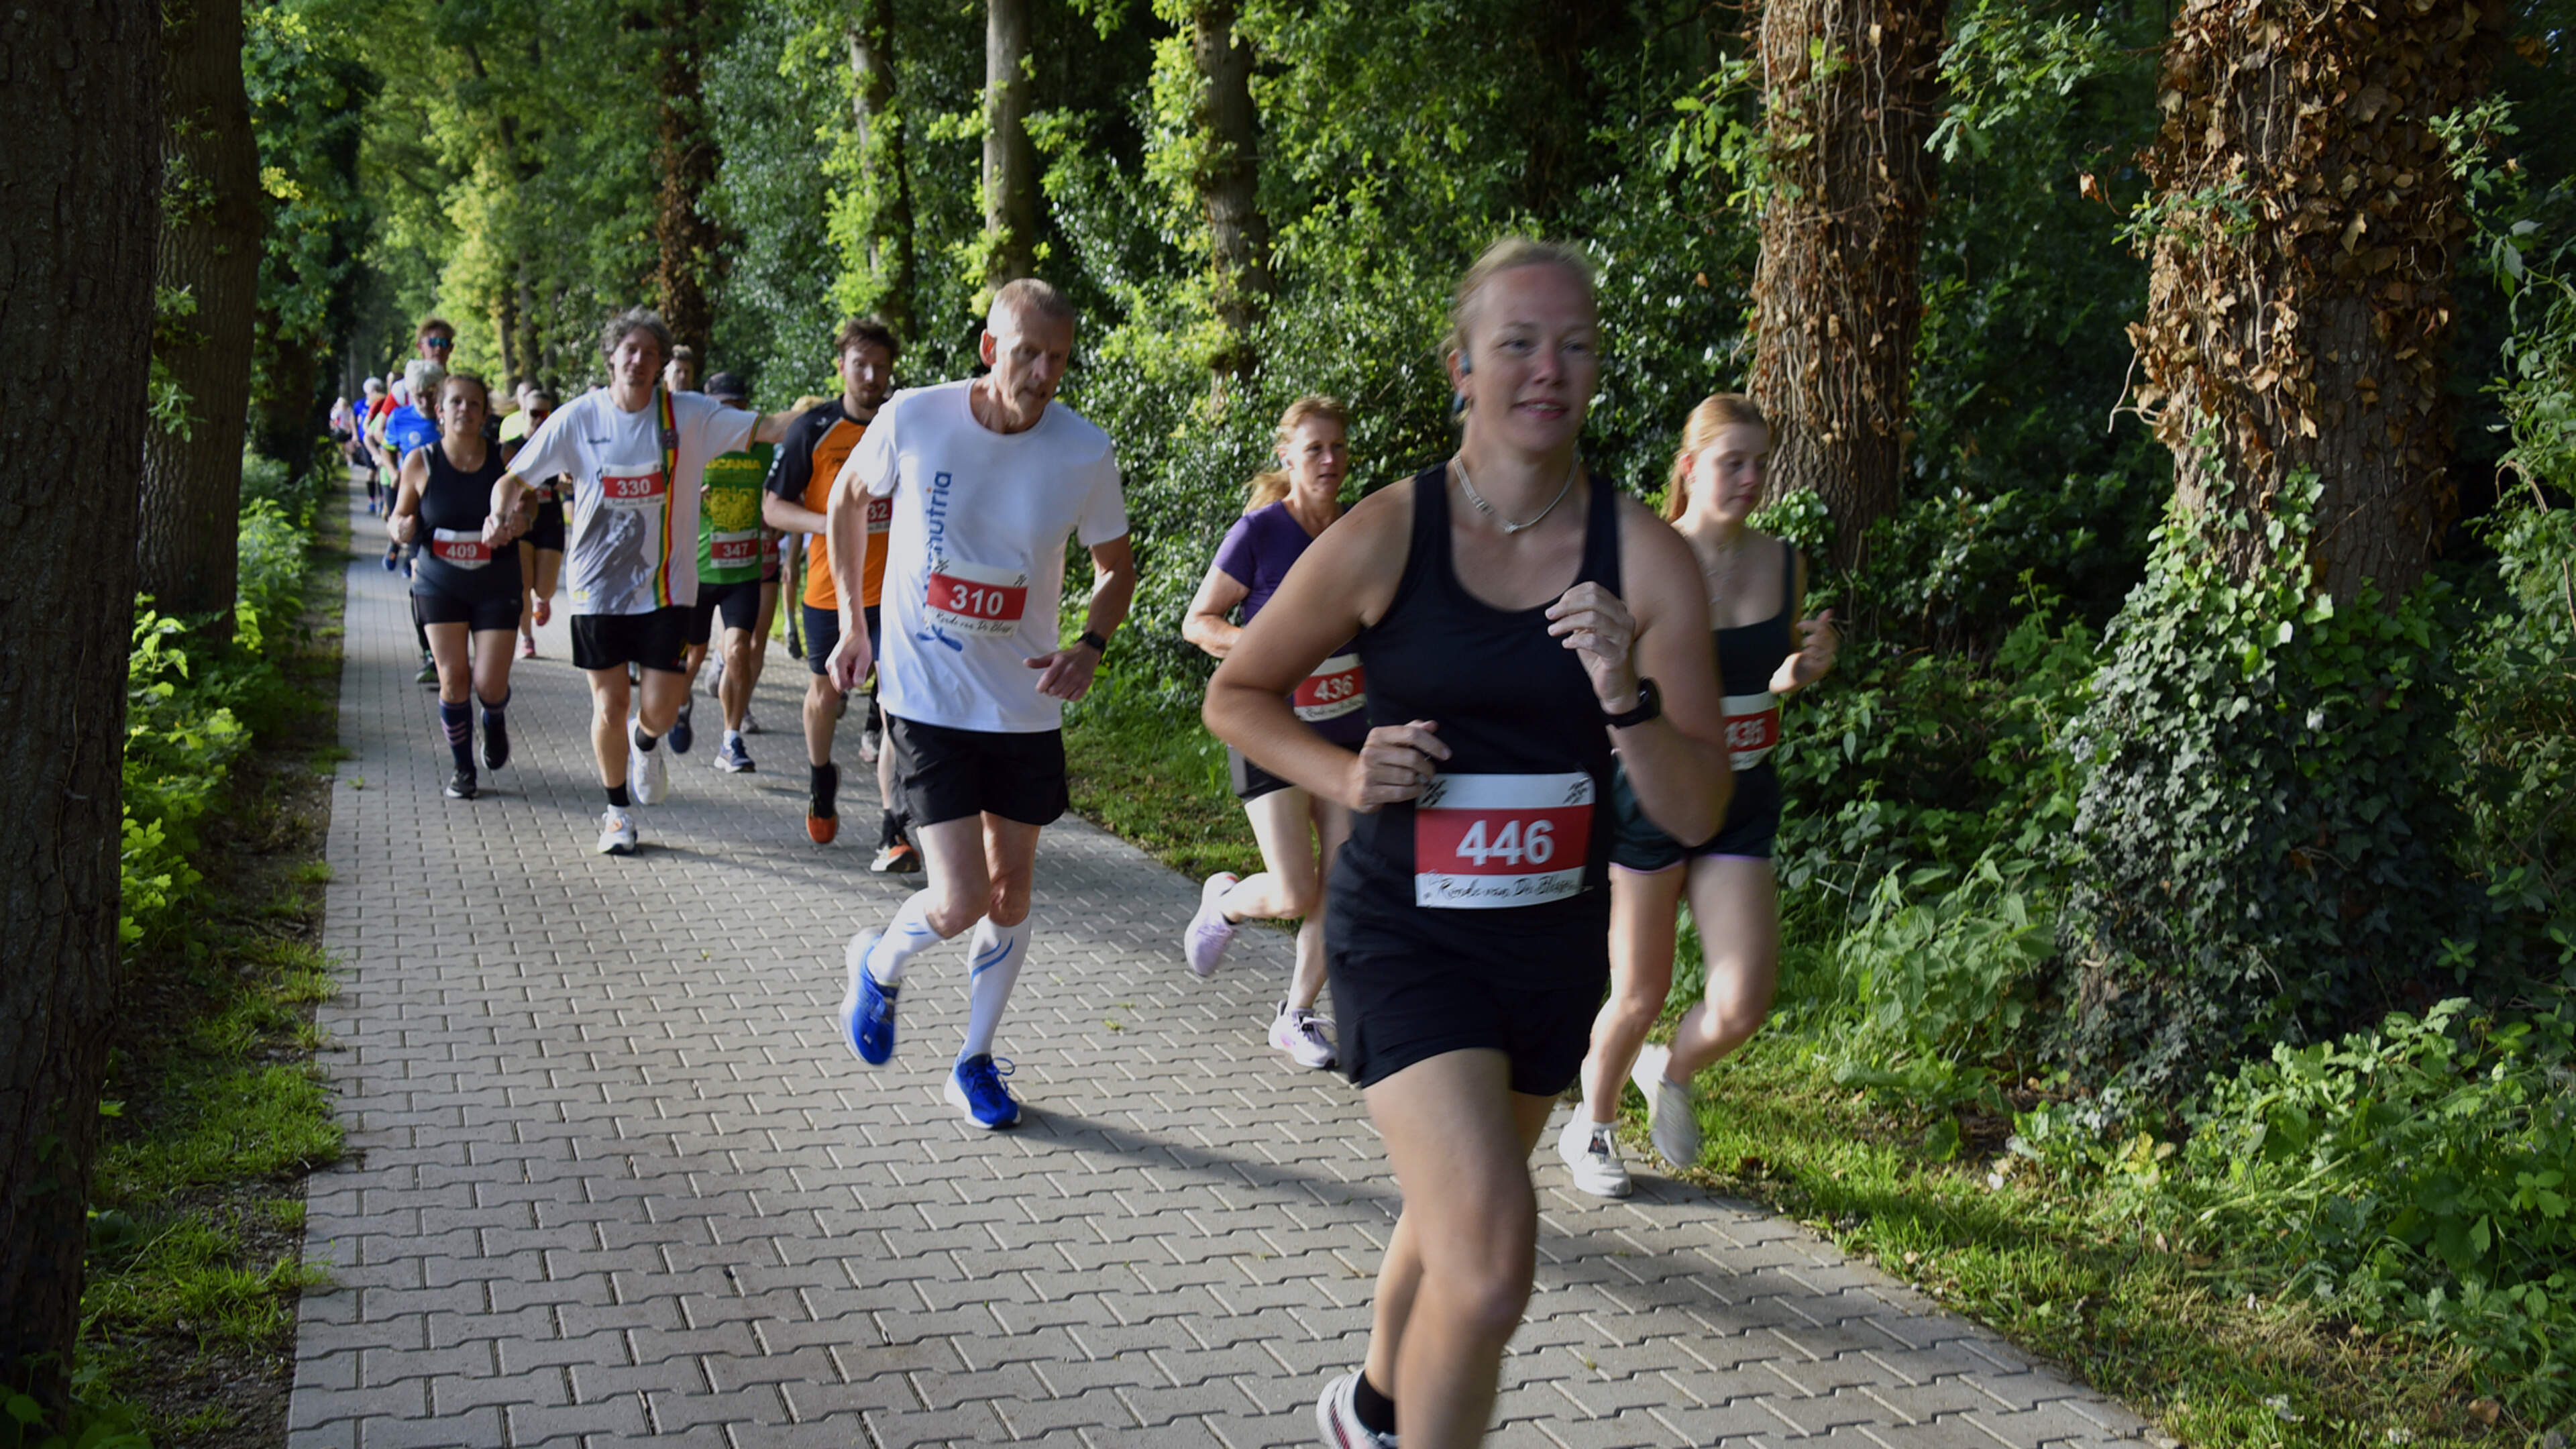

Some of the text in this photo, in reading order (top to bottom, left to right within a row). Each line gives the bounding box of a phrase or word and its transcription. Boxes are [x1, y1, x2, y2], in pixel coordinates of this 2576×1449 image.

[617, 479, 651, 496] 330
[446, 543, 478, 558] 409
[722, 543, 749, 557] 347
[950, 584, 1004, 616] 310
[1313, 674, 1354, 701] 436
[1456, 819, 1555, 866] 446
